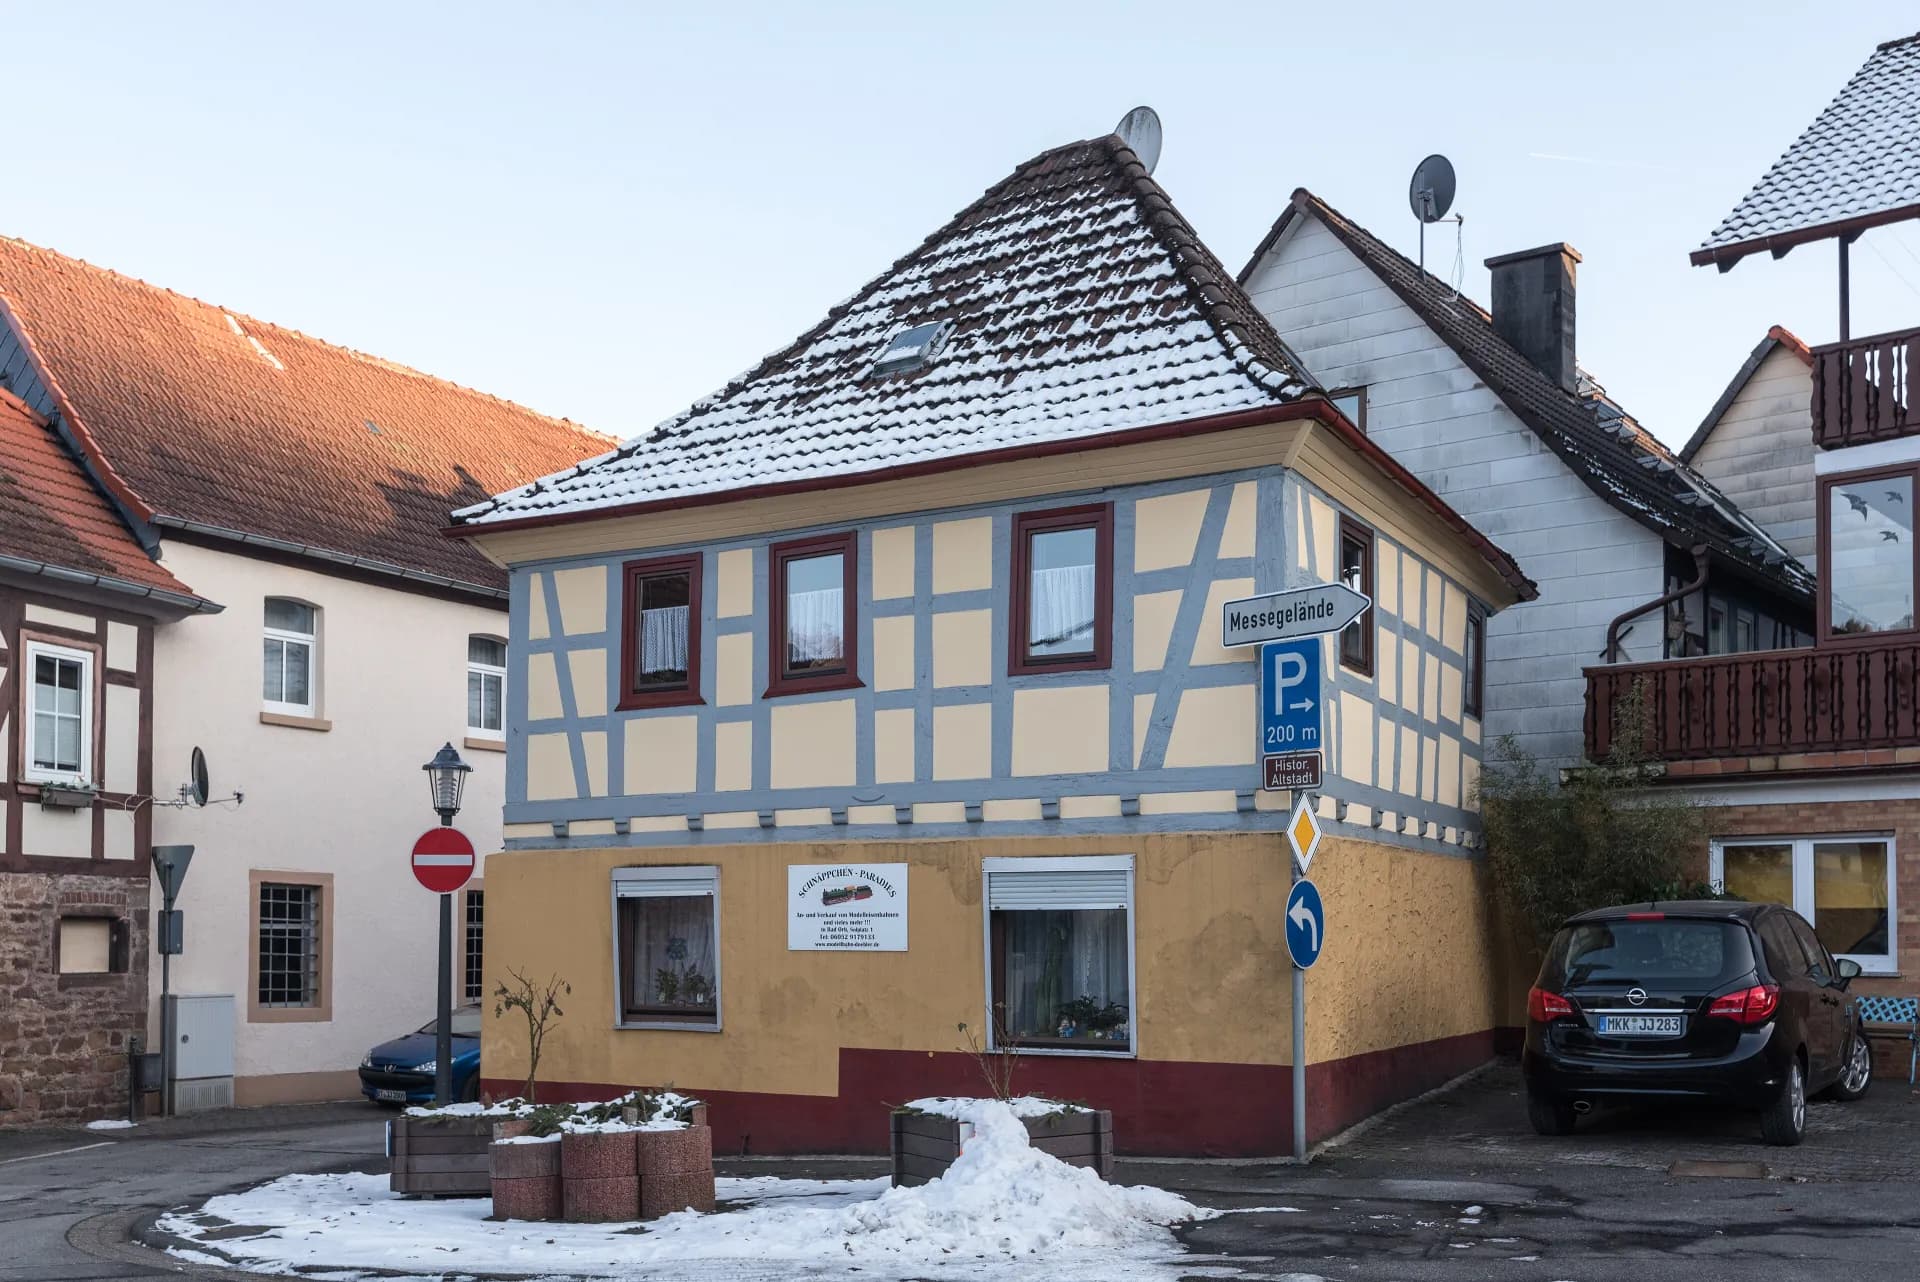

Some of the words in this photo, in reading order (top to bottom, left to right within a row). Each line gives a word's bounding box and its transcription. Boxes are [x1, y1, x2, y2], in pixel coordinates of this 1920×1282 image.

[1230, 598, 1334, 632] Messegelände
[1274, 652, 1307, 716] P
[1267, 725, 1295, 744] 200
[1302, 727, 1317, 741] m
[1275, 759, 1309, 772] Histor.
[1271, 772, 1313, 786] Altstadt
[798, 867, 854, 898] SCHNÄPPCHEN
[859, 869, 897, 898] PARADIES
[1607, 1016, 1630, 1032] MKK
